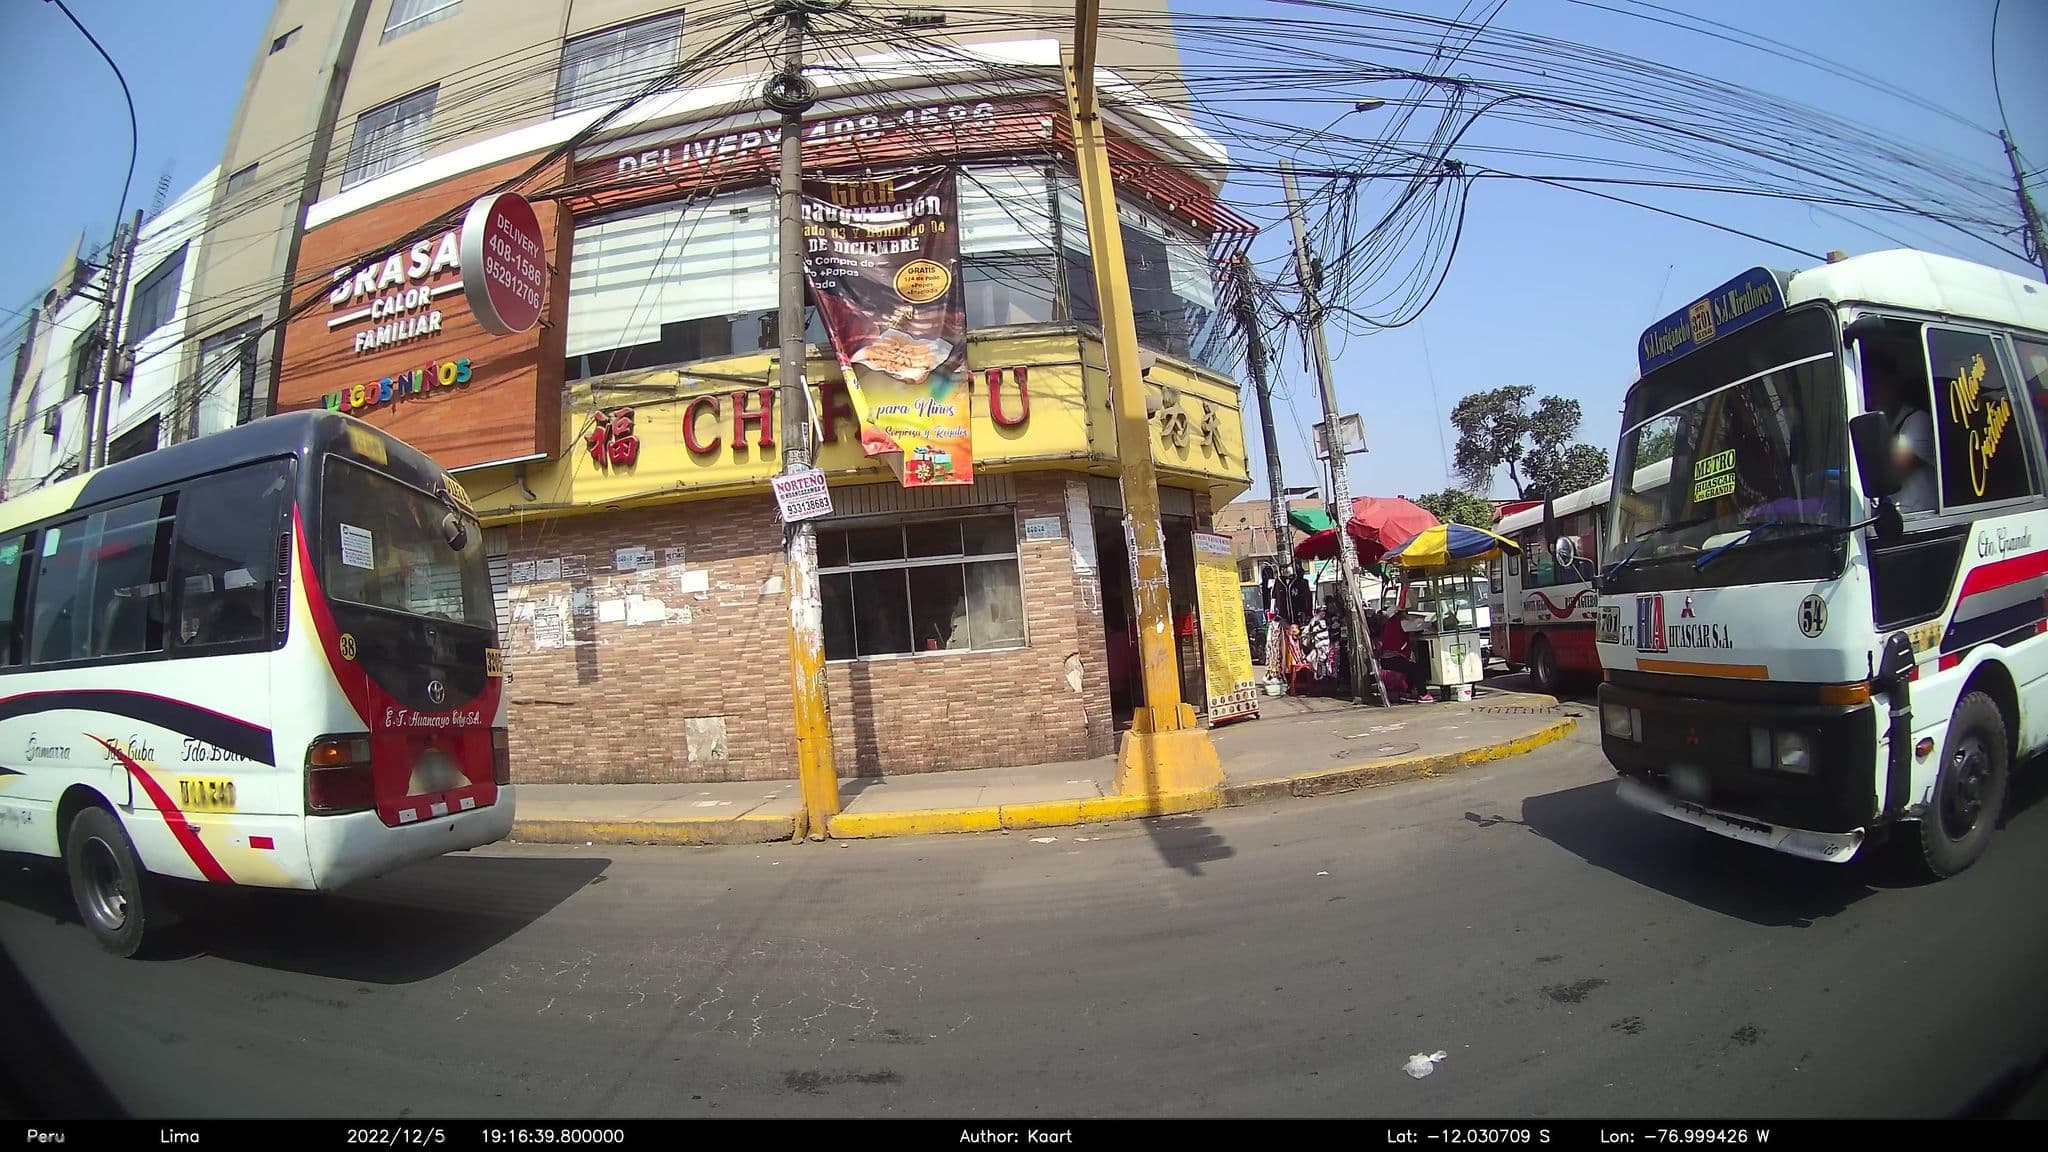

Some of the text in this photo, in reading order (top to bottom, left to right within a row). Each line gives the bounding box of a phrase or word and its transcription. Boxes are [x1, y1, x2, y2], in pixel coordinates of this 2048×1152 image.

[830, 180, 896, 206] Gran
[801, 195, 942, 225] nauguración
[497, 213, 540, 259] DELIVERY
[803, 224, 825, 237] ado
[831, 227, 846, 240] 03
[931, 220, 946, 234] 04
[808, 236, 920, 257] DE DICIEMBRE
[330, 231, 462, 304] BRASA
[489, 233, 541, 287] 408-1586
[815, 256, 858, 267] Compra
[907, 266, 936, 274] GRATIS
[486, 256, 540, 309] 952912706
[371, 286, 432, 319] CALOR
[355, 311, 443, 352] FAMILIAR
[1692, 310, 1713, 333] 3701
[398, 357, 473, 397] NIÑOS
[876, 405, 910, 419] para
[1695, 450, 1735, 479] METRO
[776, 473, 825, 493] NORTEÑO
[1696, 473, 1735, 492] HUASCAR
[787, 497, 830, 514] 933138683
[1636, 594, 1668, 653] HA
[1802, 600, 1824, 633] 54
[341, 637, 356, 657] 38
[1669, 624, 1710, 649] HUASCAR
[409, 711, 451, 729] Huancayo
[25, 732, 72, 762] Gamarra
[127, 733, 155, 762] Cuba
